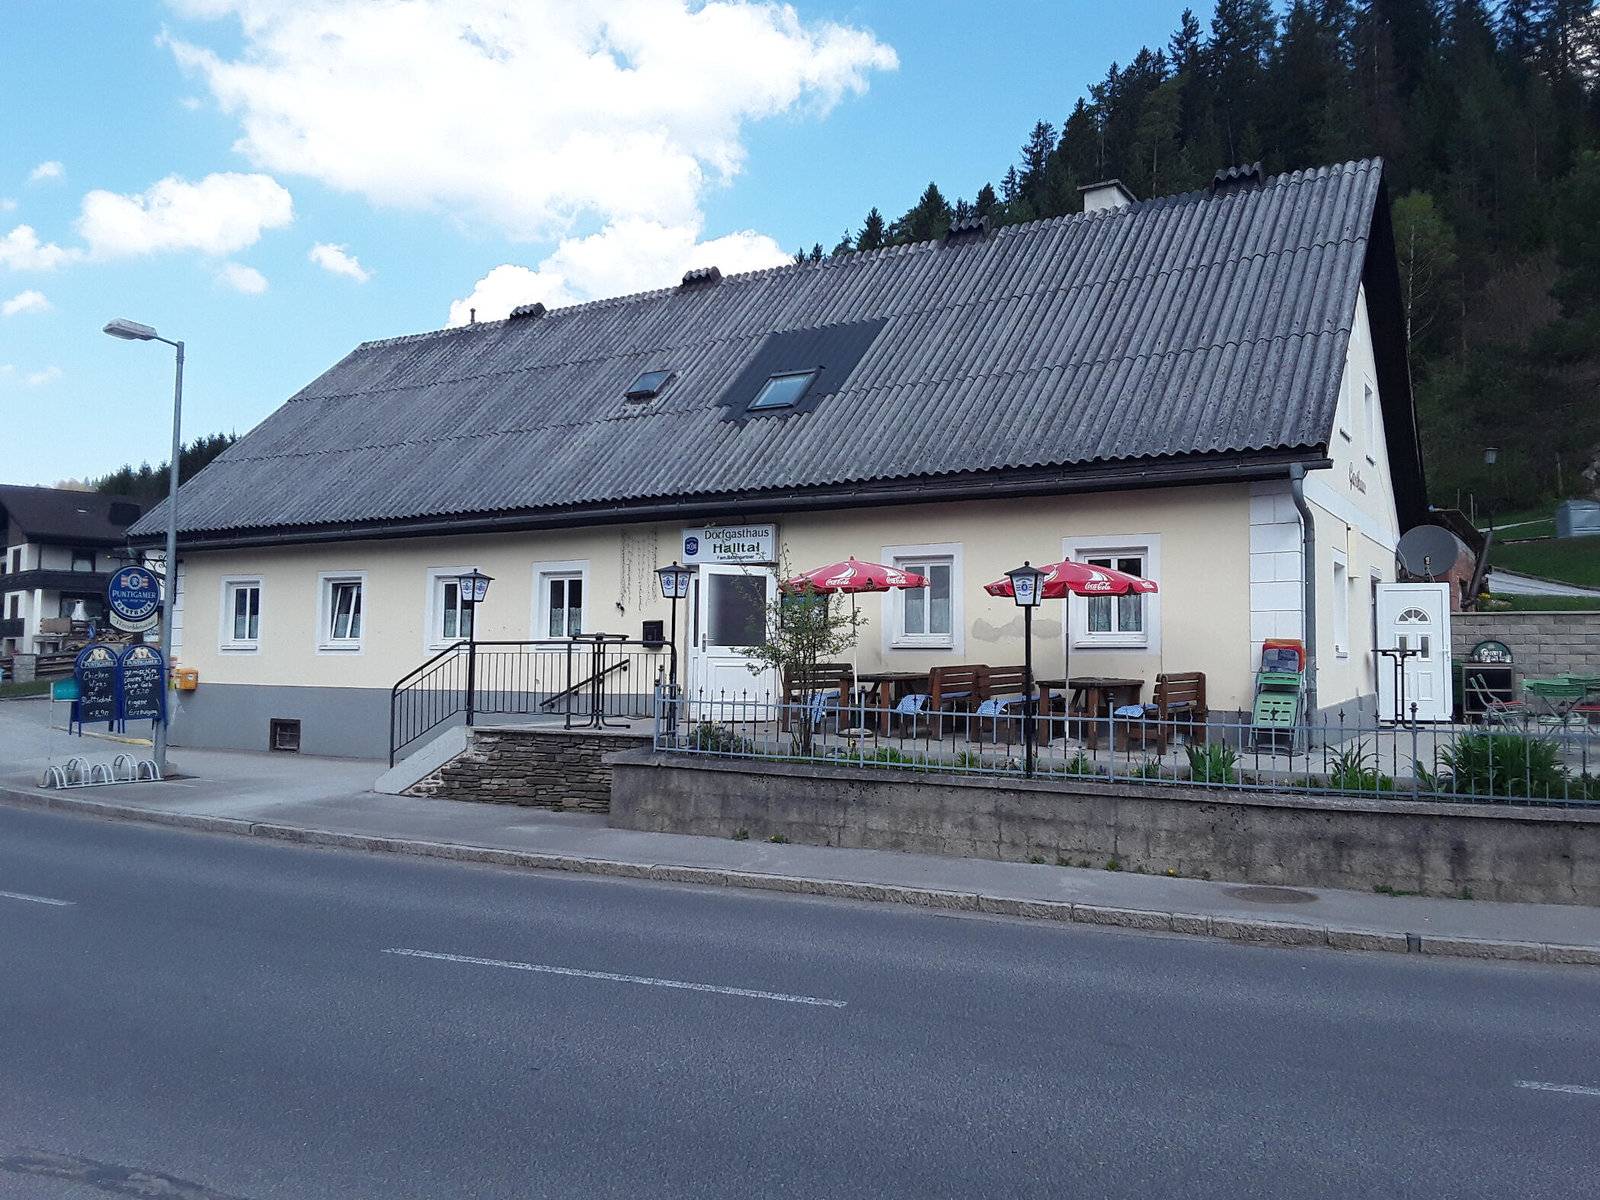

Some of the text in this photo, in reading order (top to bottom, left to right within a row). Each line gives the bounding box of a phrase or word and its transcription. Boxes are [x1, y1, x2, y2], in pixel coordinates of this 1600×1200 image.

[704, 528, 770, 541] Dorfgasthaus
[712, 542, 760, 554] Halltal
[112, 590, 156, 599] PUNTIGAMER
[116, 602, 152, 615] GASTHAUS
